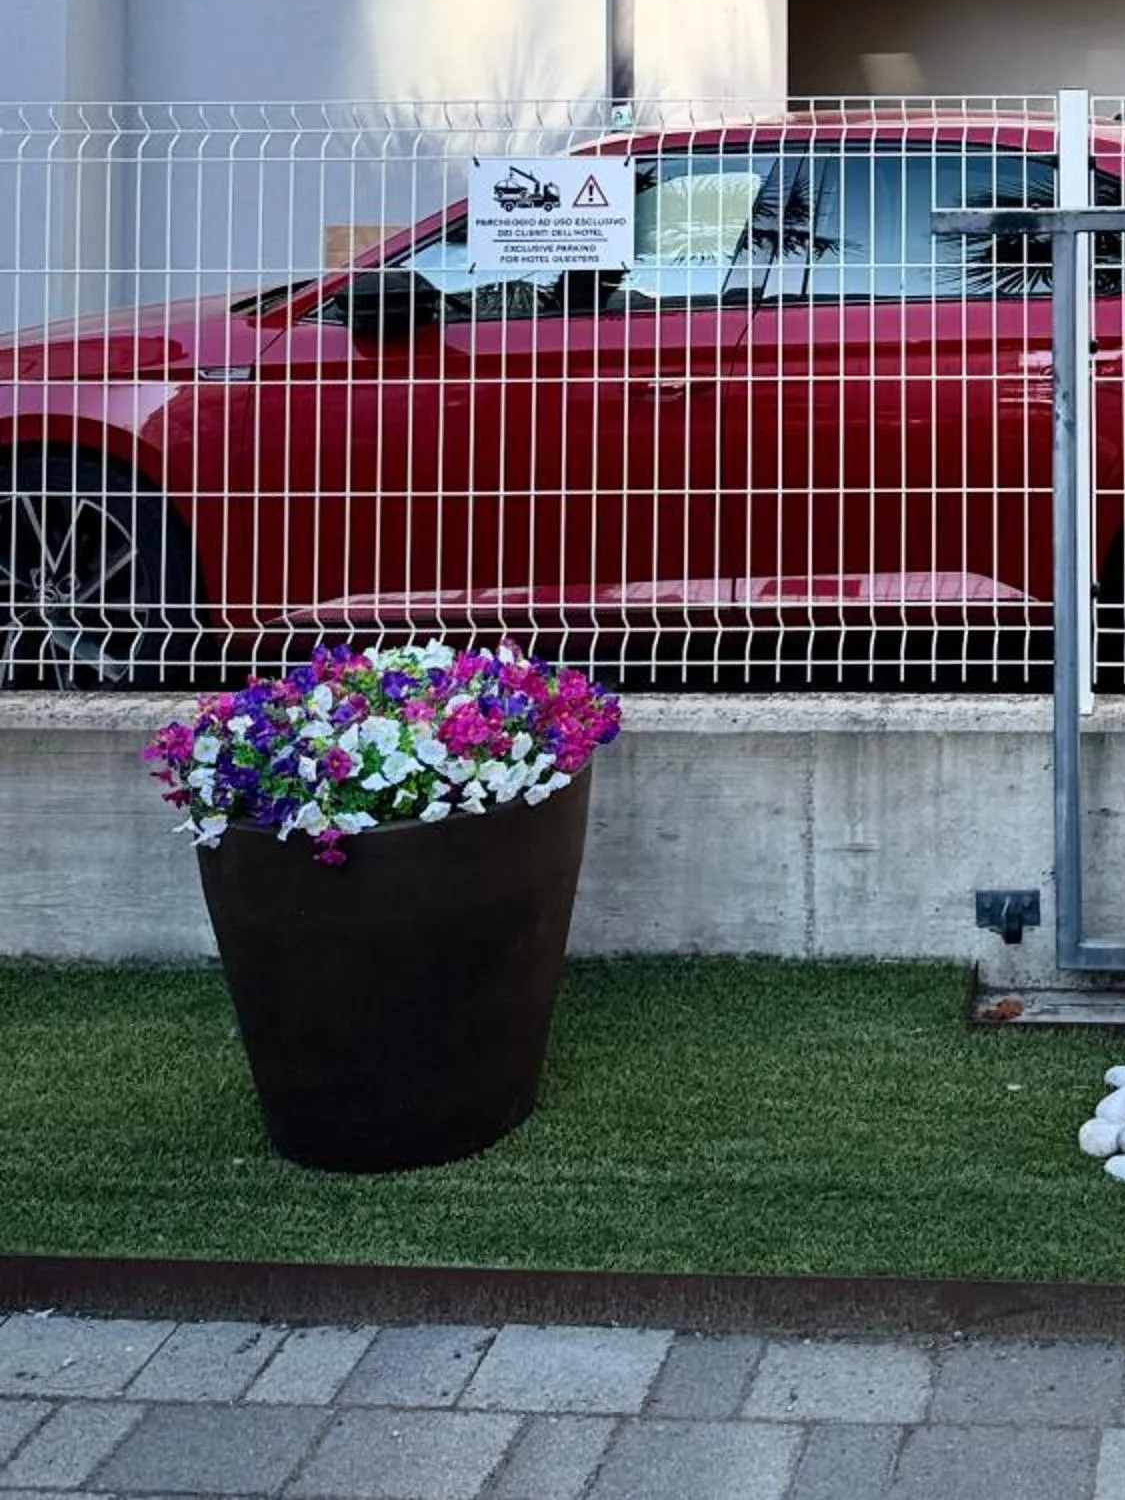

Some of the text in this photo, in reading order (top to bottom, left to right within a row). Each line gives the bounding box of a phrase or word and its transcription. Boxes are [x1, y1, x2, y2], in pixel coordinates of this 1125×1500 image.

[475, 218, 627, 227] PARCHEGGIO AD USO ESCLUSIVO
[497, 229, 605, 237] DEI CLIENTI DELL'HOTEL
[503, 244, 597, 253] EXCLUSIVE PARKING
[500, 255, 519, 264] FOR
[521, 255, 550, 264] HOTEL
